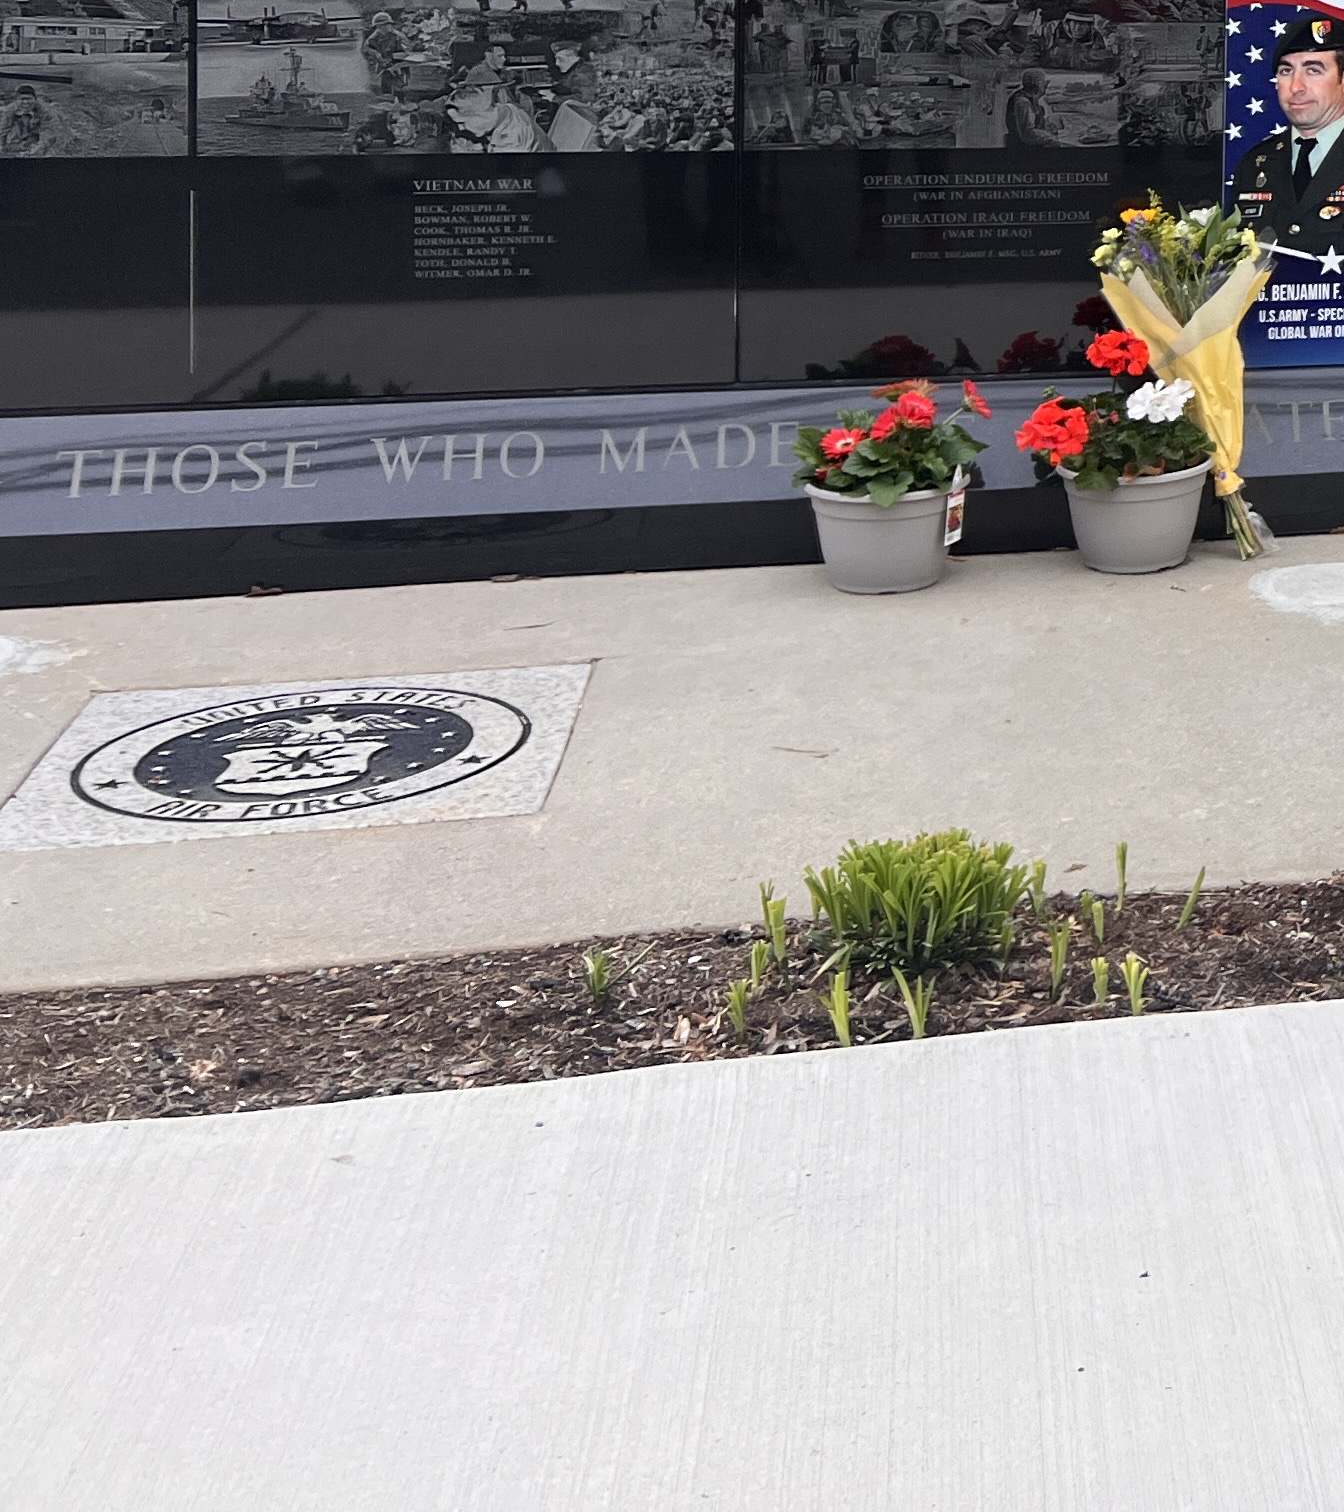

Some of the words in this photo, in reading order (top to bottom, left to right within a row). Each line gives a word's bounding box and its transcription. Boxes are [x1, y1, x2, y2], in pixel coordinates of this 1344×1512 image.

[413, 179, 491, 191] VIETNAM
[497, 178, 534, 190] WAR
[863, 174, 950, 186] OPERATION
[954, 172, 1033, 185] ENDURING
[1038, 171, 1109, 184] FREEDOM
[912, 190, 947, 202] (WAR
[950, 190, 964, 201] IN
[967, 189, 1062, 201] AFGHANISTAN)
[451, 203, 492, 213] JOSEPH
[473, 214, 518, 224] ROBERT
[881, 212, 968, 225] OPERATION
[972, 211, 1015, 224] IRAQI
[1019, 210, 1091, 222] FREEDOM
[454, 225, 501, 235] THOMAS
[942, 228, 976, 240] (WAR
[979, 228, 993, 238] IN
[996, 226, 1033, 239] IRAQ)
[466, 247, 506, 256] RANDY
[451, 257, 499, 267] DONALD
[1271, 283, 1330, 302] BENJAMIN
[1333, 283, 1342, 300] F.
[1267, 325, 1307, 340] GLOBAL
[1309, 324, 1333, 339] WAR
[55, 440, 321, 499] THOSE
[370, 430, 545, 485] WHO
[598, 420, 801, 475] MADE
[181, 695, 321, 727] UNITED
[344, 690, 480, 711] STATES
[144, 799, 222, 818] AIR
[240, 789, 394, 819] FORCE
